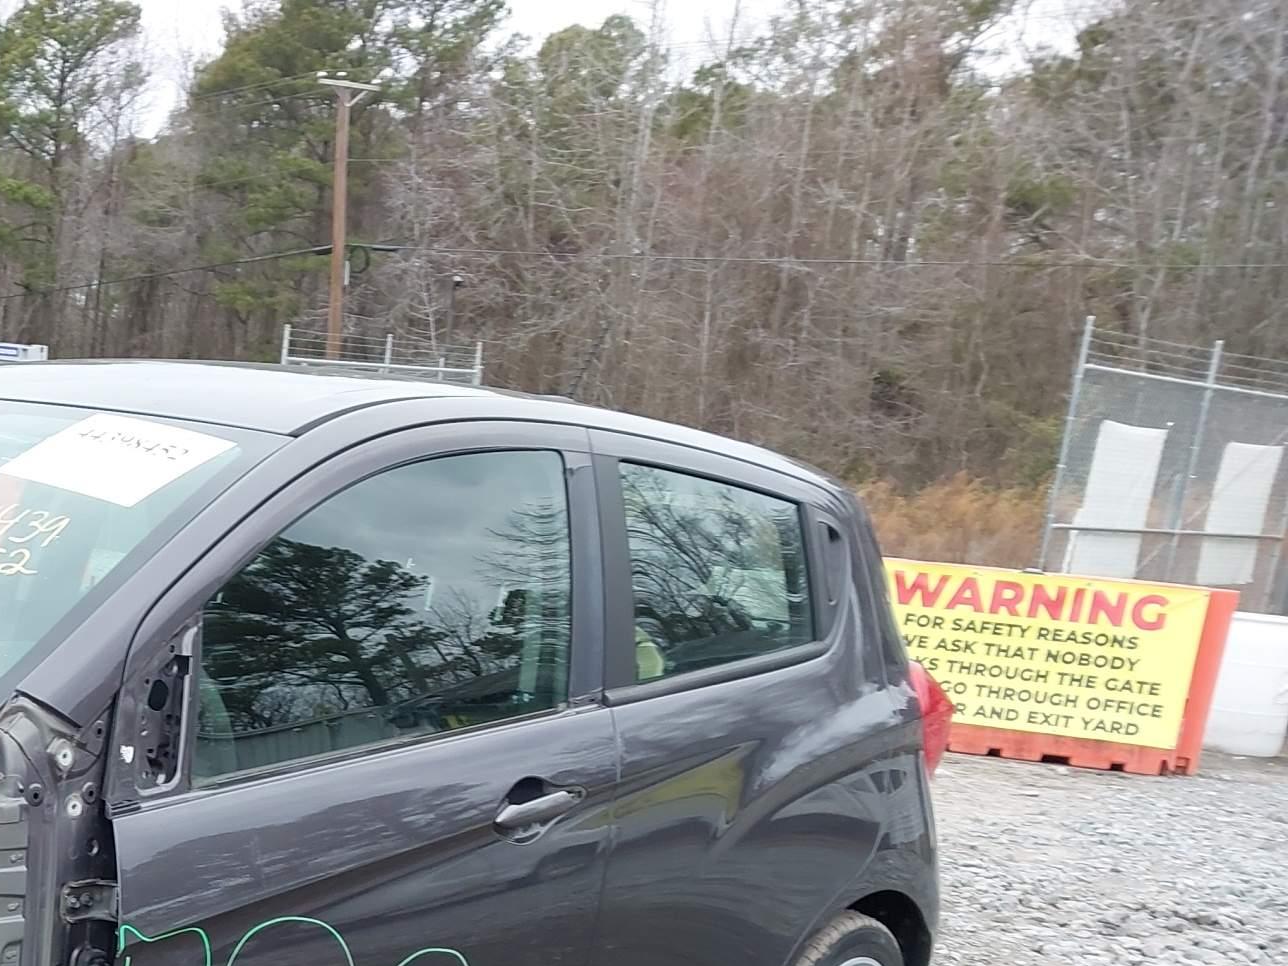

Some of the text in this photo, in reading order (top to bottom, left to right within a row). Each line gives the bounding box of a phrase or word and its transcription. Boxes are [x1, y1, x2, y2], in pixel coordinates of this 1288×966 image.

[894, 570, 1169, 631] WARNING
[903, 612, 1140, 650] FOR SAFETY REASONS
[934, 638, 978, 655] ASK
[983, 642, 1039, 661] THAT
[1045, 649, 1141, 671] NOBODY
[947, 660, 1049, 683] THROUGH
[1057, 672, 1098, 689] THE
[1105, 678, 1162, 696] GATE
[975, 684, 1079, 708] THROUGH
[1086, 697, 1164, 718] OFFICE
[973, 705, 1019, 722] AND
[1027, 711, 1074, 728] EXIT
[1081, 717, 1140, 736] YARD
